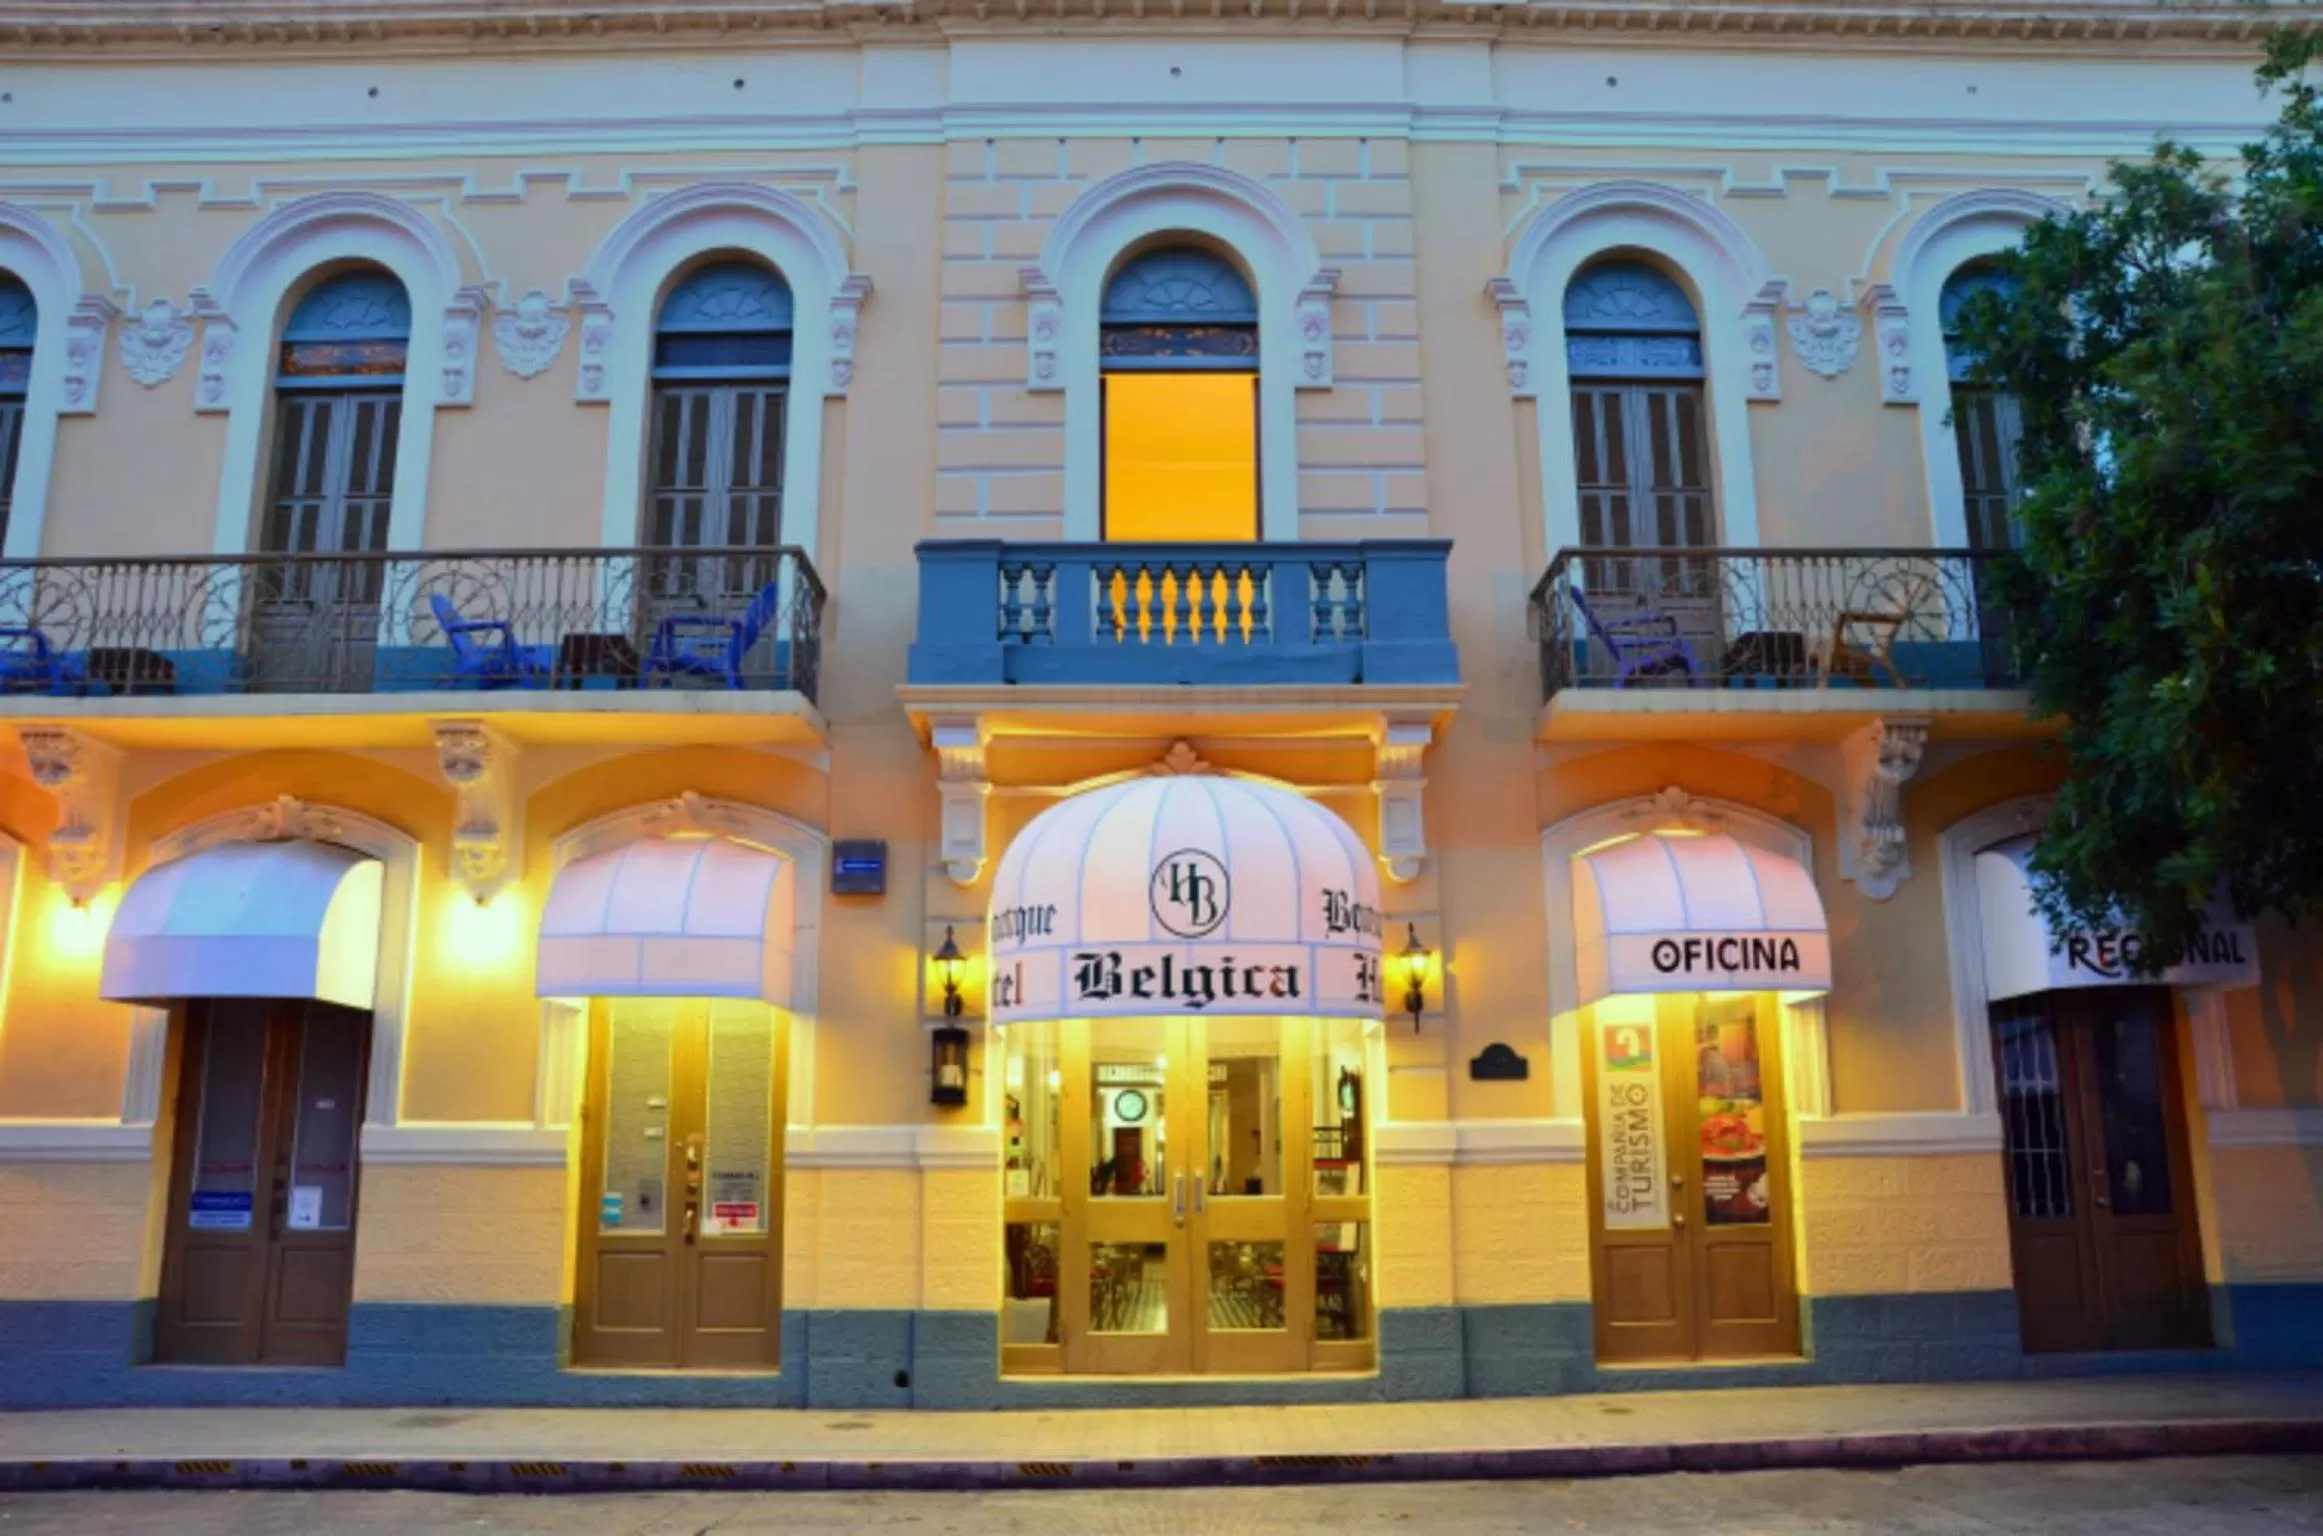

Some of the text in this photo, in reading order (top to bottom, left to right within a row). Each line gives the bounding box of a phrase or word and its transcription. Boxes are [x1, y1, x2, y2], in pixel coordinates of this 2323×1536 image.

[1074, 951, 1301, 1008] Belgica
[1652, 937, 1800, 973] OFICINA
[1626, 1083, 1653, 1213] TURISMO
